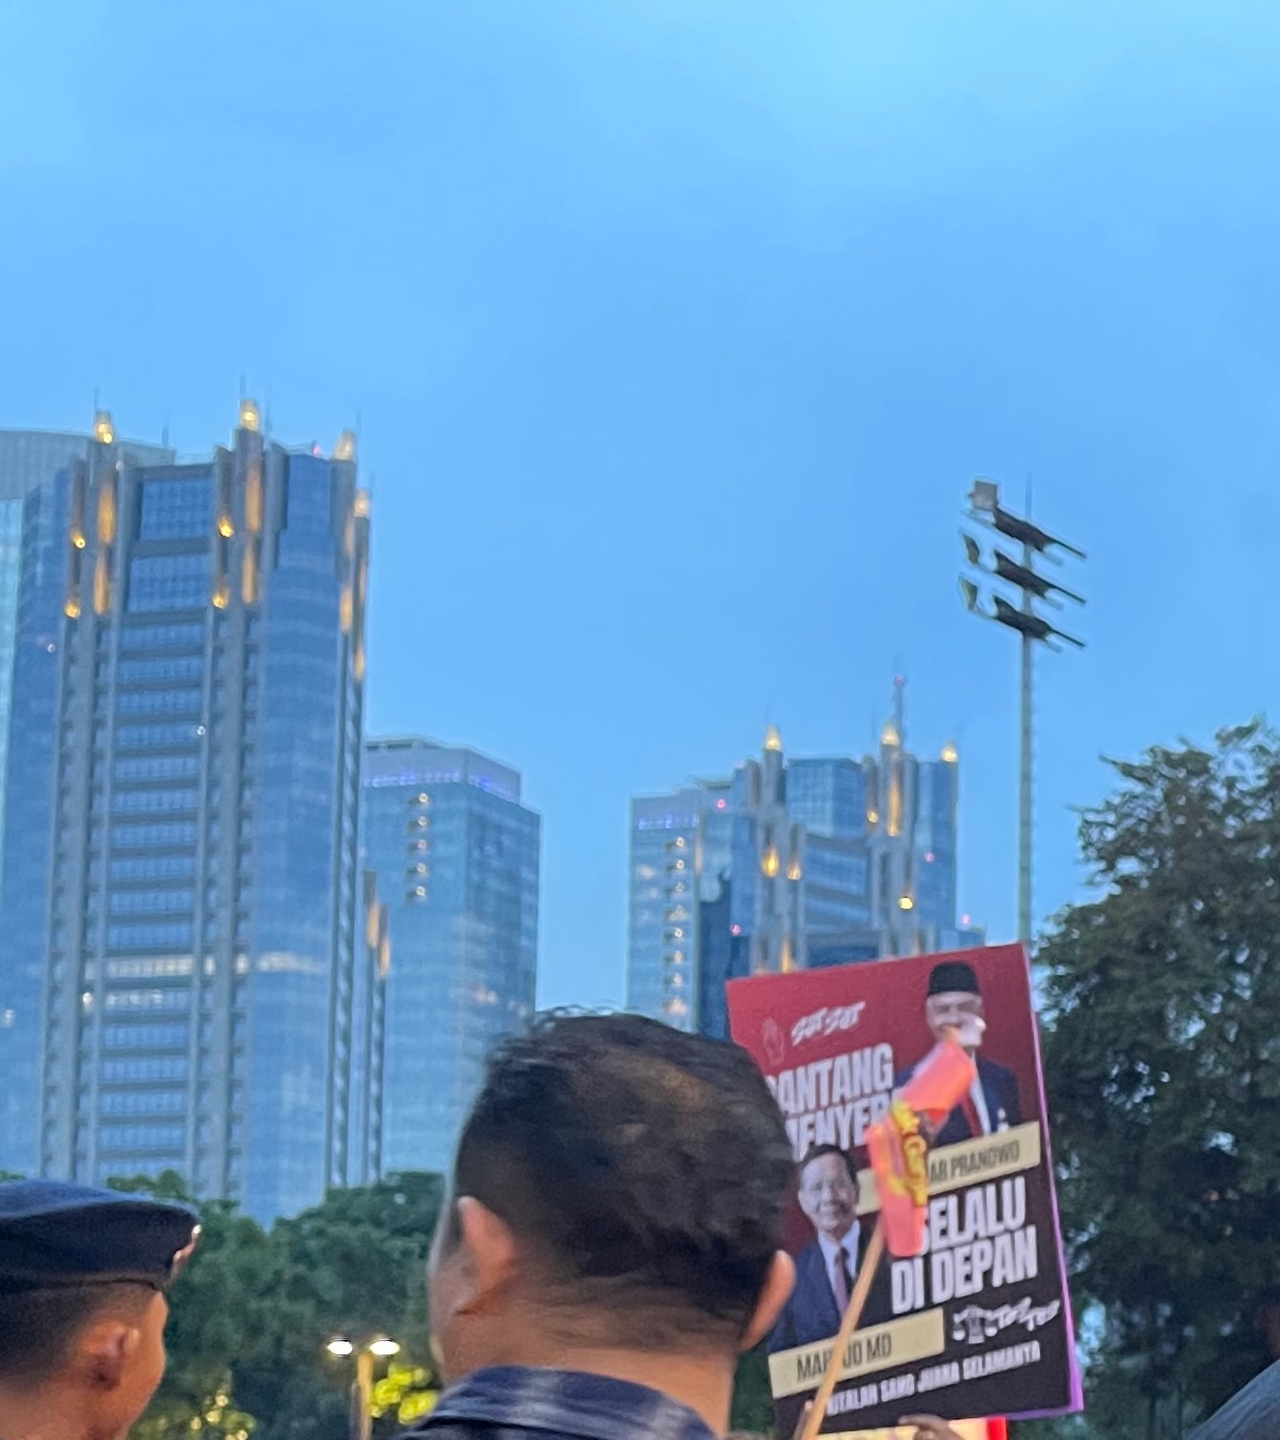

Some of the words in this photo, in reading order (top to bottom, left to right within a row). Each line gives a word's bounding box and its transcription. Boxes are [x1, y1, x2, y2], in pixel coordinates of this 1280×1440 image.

[765, 1043, 894, 1114] ANTANG
[891, 1258, 925, 1315] DI
[931, 1224, 1038, 1304] DEPAN
